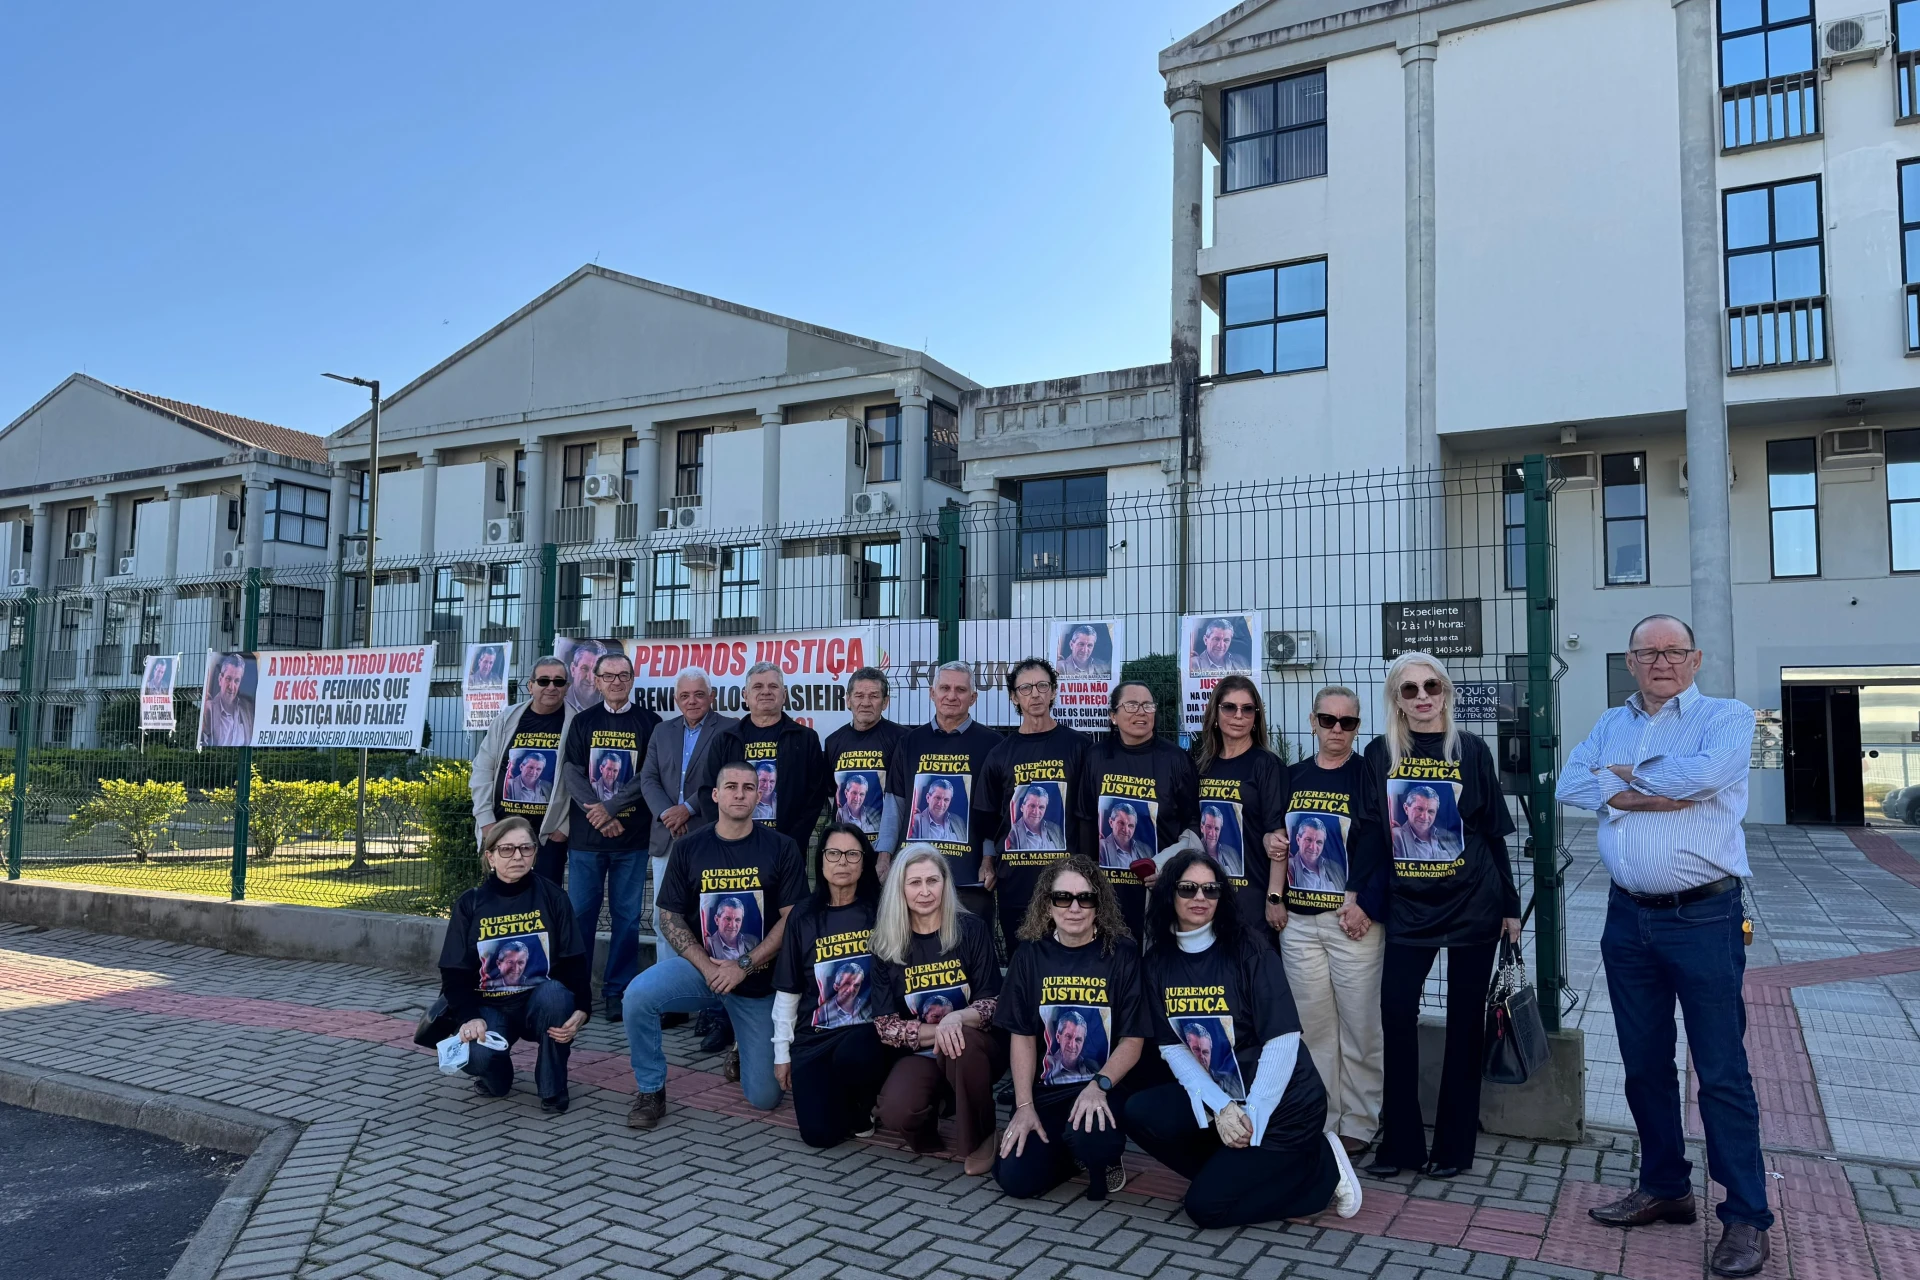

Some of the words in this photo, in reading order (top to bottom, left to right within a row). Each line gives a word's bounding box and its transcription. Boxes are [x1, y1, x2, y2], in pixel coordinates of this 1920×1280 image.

[1403, 607, 1458, 617] Expediente
[1396, 621, 1407, 630] 12
[1424, 620, 1435, 629] 19
[1438, 620, 1466, 629] horas
[268, 657, 277, 676] A
[280, 652, 343, 676] VIOLÊNCIA
[347, 653, 386, 675] TIROU
[388, 648, 425, 674] VOCÊ
[634, 642, 747, 677] PEDIMOS
[755, 638, 864, 681] JUSTIÇA
[273, 680, 290, 700] DE
[291, 677, 318, 702] NÓS,
[322, 678, 380, 700] PEDIMOS
[383, 677, 410, 701] QUE
[1060, 682, 1066, 693] A
[1067, 682, 1088, 693] VIDA
[1090, 680, 1108, 693] NÃO
[1455, 686, 1485, 696] OQUE
[1487, 686, 1496, 695] O
[783, 684, 852, 712] ASIEIR
[1060, 695, 1077, 705] TEM
[1190, 692, 1200, 700] NA
[271, 704, 279, 725] A
[281, 704, 332, 729] JUSTIÇA
[335, 700, 361, 725] NÃO
[364, 703, 407, 725] FALHE!
[1053, 708, 1067, 717] QUE
[1068, 708, 1078, 717] OS
[1080, 708, 1110, 717] CULPAD
[1075, 718, 1110, 727] CONDENAD
[257, 731, 276, 745] RENI
[277, 731, 307, 745] CARLOS
[307, 731, 346, 745] MASIEIRO
[593, 731, 635, 739] QUEREMOS
[591, 738, 637, 748] JUSTIÇA
[834, 758, 885, 771] JUSTIÇA
[920, 754, 970, 762] QUEREMOS
[916, 761, 971, 773] JUSTIÇA
[1103, 774, 1156, 786] QUEREMOS
[1101, 783, 1157, 799] JUSTIÇA
[1292, 791, 1350, 801] QUEREMOS
[1287, 799, 1350, 814] JUSTIÇA
[702, 867, 759, 879] QUEREMOS
[701, 876, 761, 892] JUSTIÇA
[480, 909, 541, 927] QUEREMOS
[478, 919, 545, 940] JUSTIÇA
[815, 940, 871, 962] JUSTIÇ
[905, 958, 961, 977] QUEREMOS
[905, 969, 966, 993] JUSTIÇA
[1043, 976, 1106, 988] QUEREMOS
[1040, 987, 1108, 1004] JUSTIÇA
[1165, 986, 1225, 998] QUEREMOS
[1165, 997, 1229, 1017] JUSTIÇA
